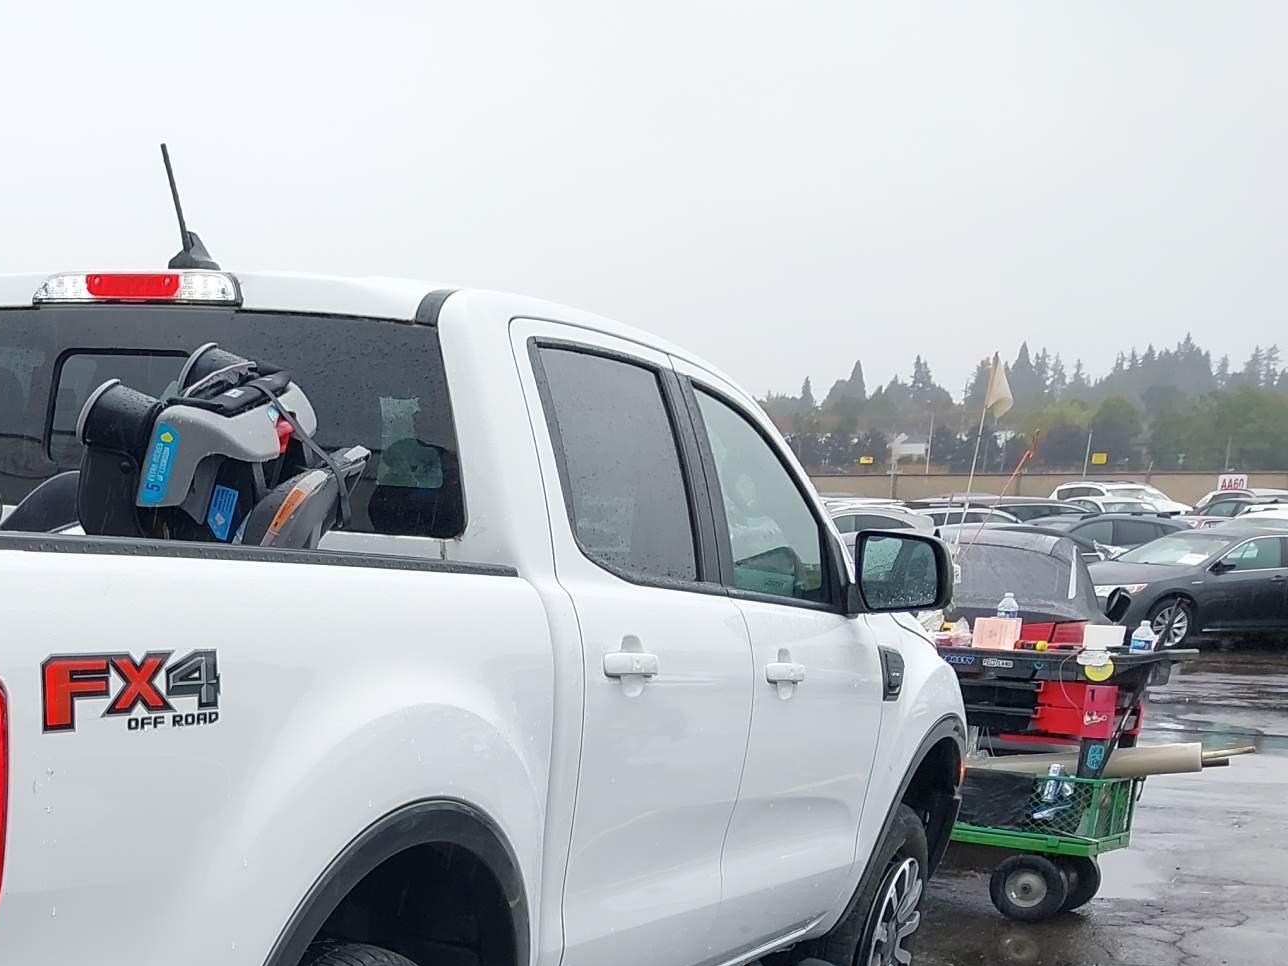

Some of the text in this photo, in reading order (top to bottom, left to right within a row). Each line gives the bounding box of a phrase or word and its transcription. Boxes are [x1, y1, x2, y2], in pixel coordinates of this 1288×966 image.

[1221, 478, 1245, 490] AA60
[41, 649, 221, 734] FX4
[127, 711, 220, 731] OFF ROAD
